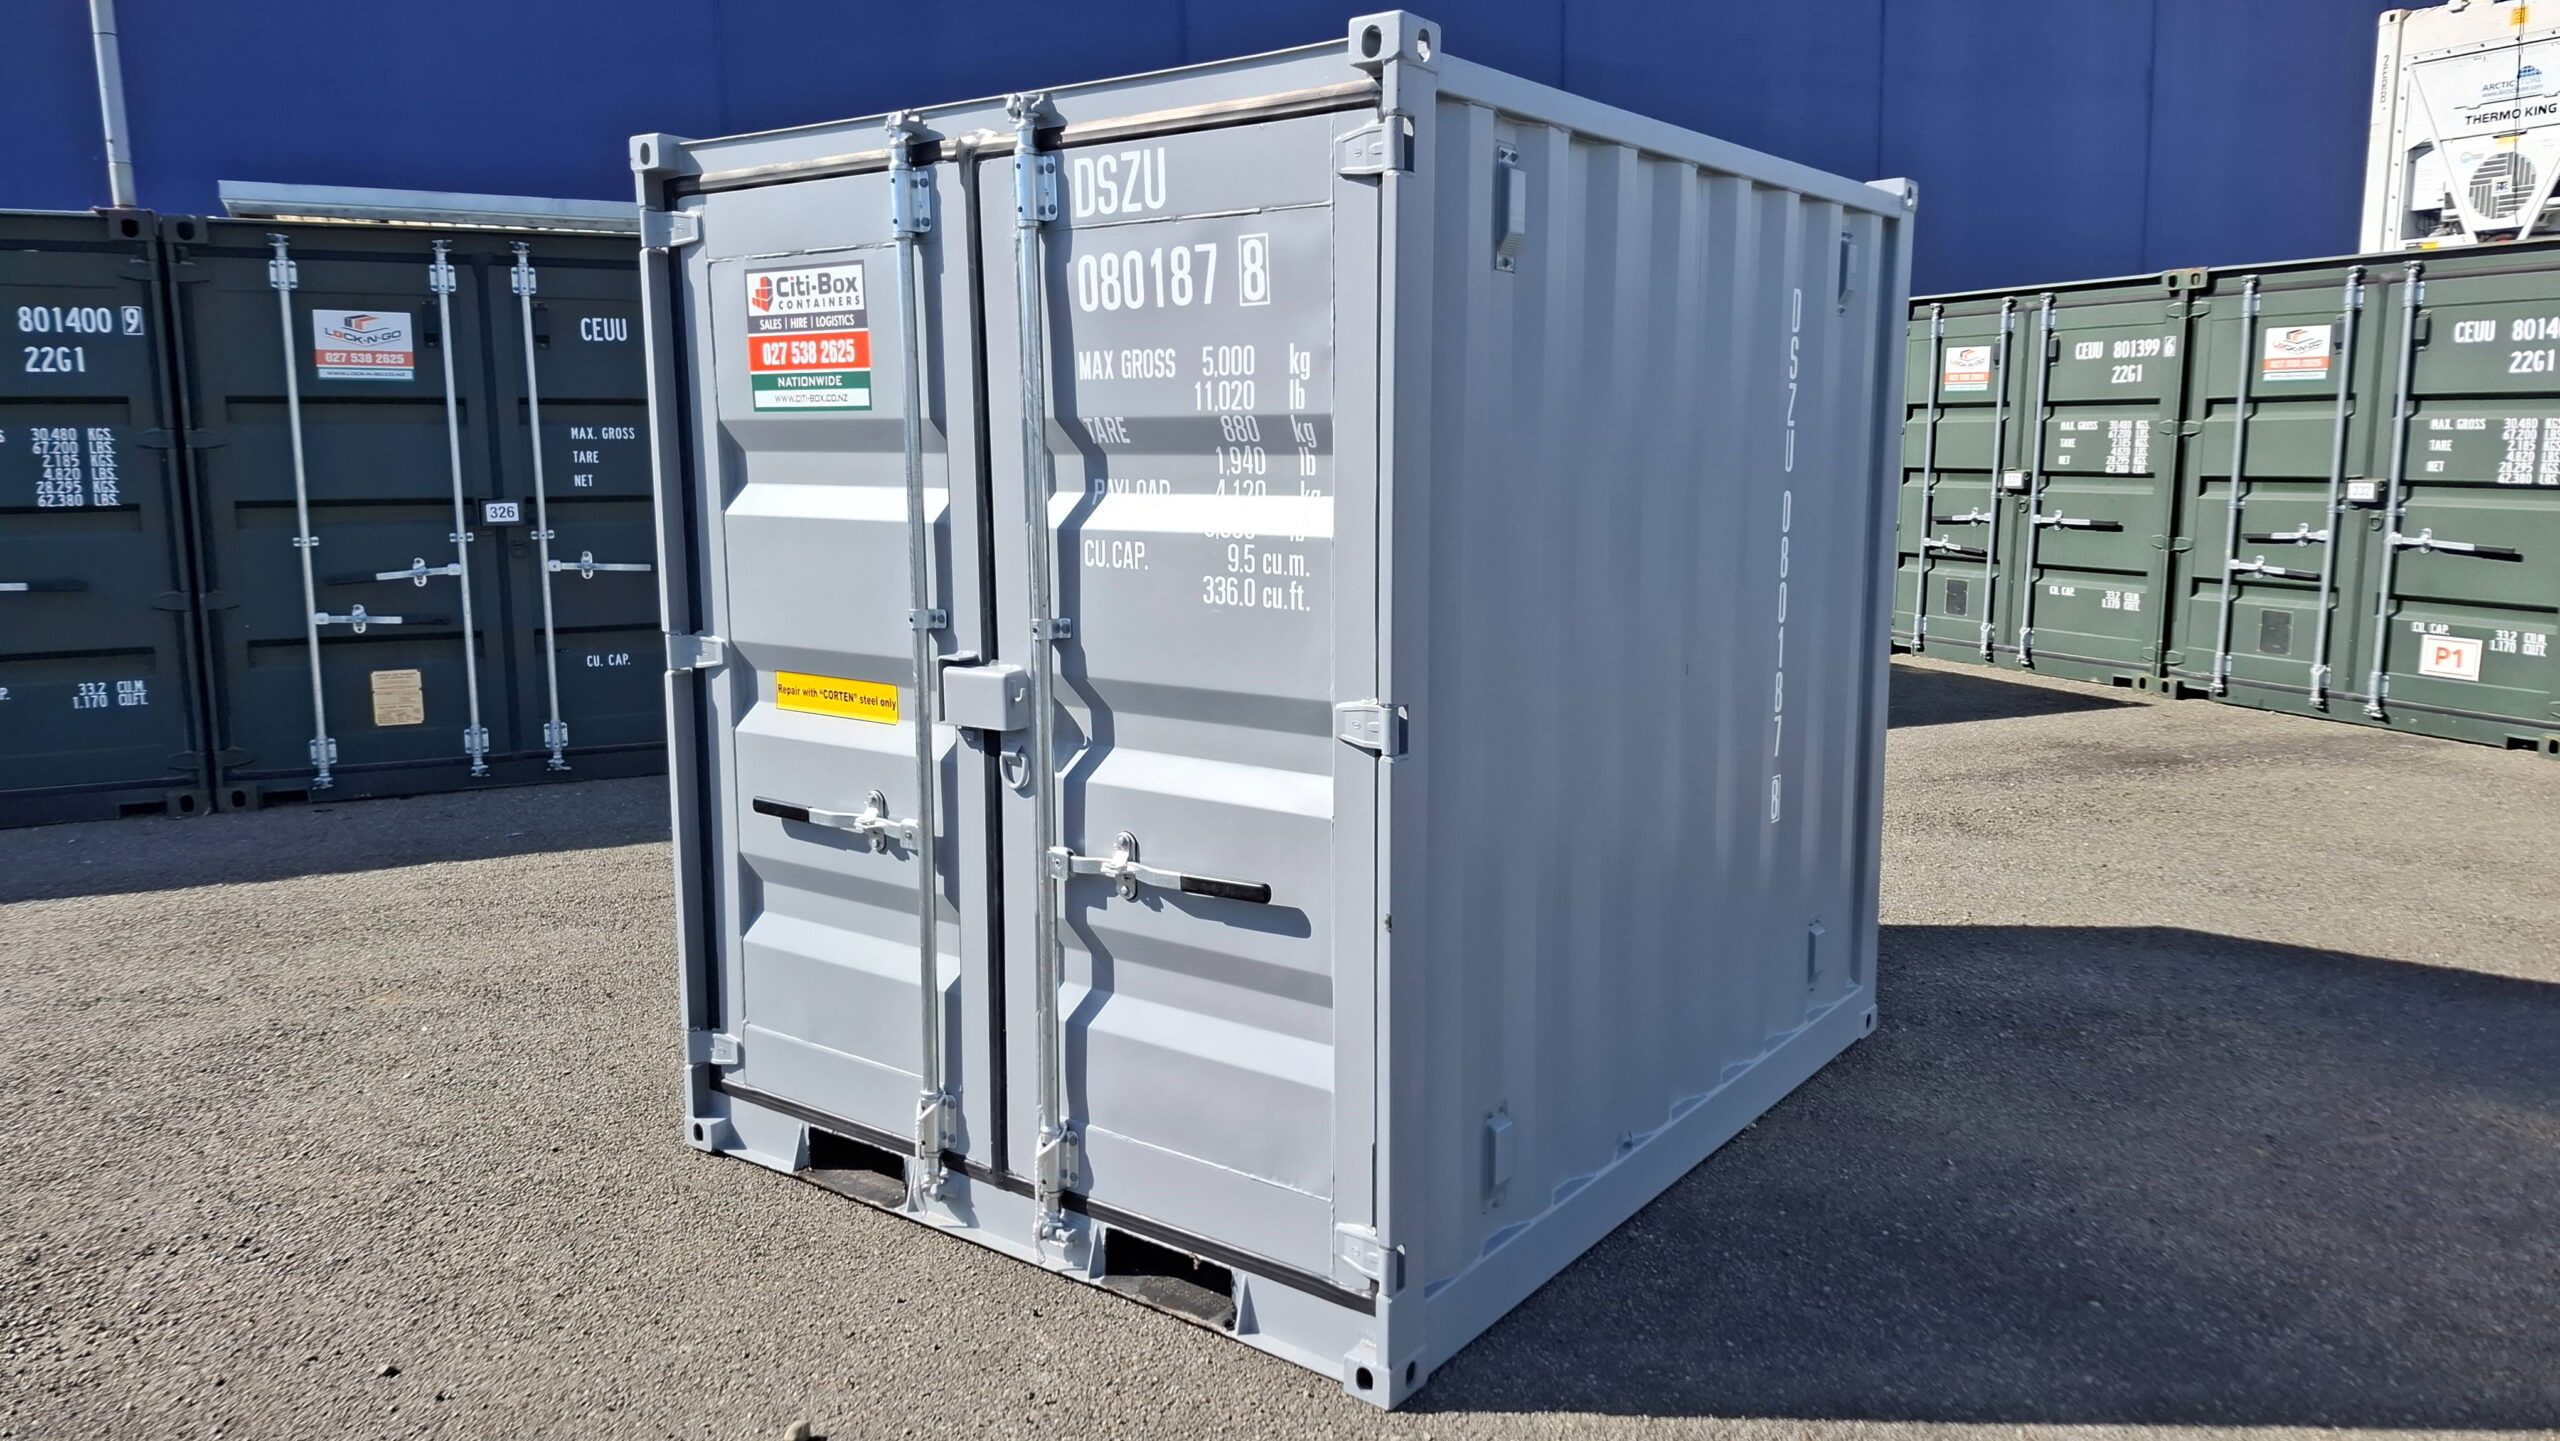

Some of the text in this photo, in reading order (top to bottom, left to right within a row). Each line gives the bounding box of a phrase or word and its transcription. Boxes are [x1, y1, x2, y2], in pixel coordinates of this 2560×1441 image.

[2465, 103, 2558, 125] THERMO KING
[1074, 147, 1166, 218] DSZU
[776, 272, 858, 298] Citi-Box
[1077, 236, 1267, 313] 080187 8
[778, 295, 861, 310] CONTAINERS
[17, 306, 141, 334] 801400 9
[580, 317, 628, 342] CEUU
[760, 314, 855, 331] SALES HIRE LOGISTICS
[2454, 316, 2560, 343] CEUU 8014
[23, 346, 86, 373] 22G1
[325, 352, 405, 364] 027 538 2625
[762, 338, 855, 366] 027 538 2625
[2075, 341, 2104, 360] CEUU
[2112, 338, 2161, 359] 801399
[1079, 343, 1311, 381] MAX GROSS 5,000 kg
[2508, 349, 2556, 373] 22G1
[777, 375, 843, 388] NATIONWIDE
[2110, 364, 2143, 384] 22G1
[774, 393, 848, 403] WWW.CITI-BOX.CO.NZ
[1194, 378, 1305, 412] 11,020 lb
[570, 427, 636, 440] MAX. GROSS
[1083, 414, 1317, 448] TARE 880 kg
[2455, 418, 2487, 430] GROSS
[2429, 439, 2453, 451] TARE
[572, 450, 600, 464] TARE
[1215, 446, 1317, 477] 1,940 lb
[574, 474, 594, 487] NET
[1215, 479, 1266, 497] 4120
[490, 505, 515, 519] 326
[1084, 540, 1310, 577] CU.CAP. 9.5 cu.m.
[1202, 576, 1311, 611] 336.0 cu.ft.
[586, 653, 631, 667] CU. CAP.
[2434, 646, 2464, 668] P1
[778, 683, 801, 696] Repair
[802, 688, 818, 697] with
[859, 695, 879, 706] steel
[880, 698, 897, 711] only
